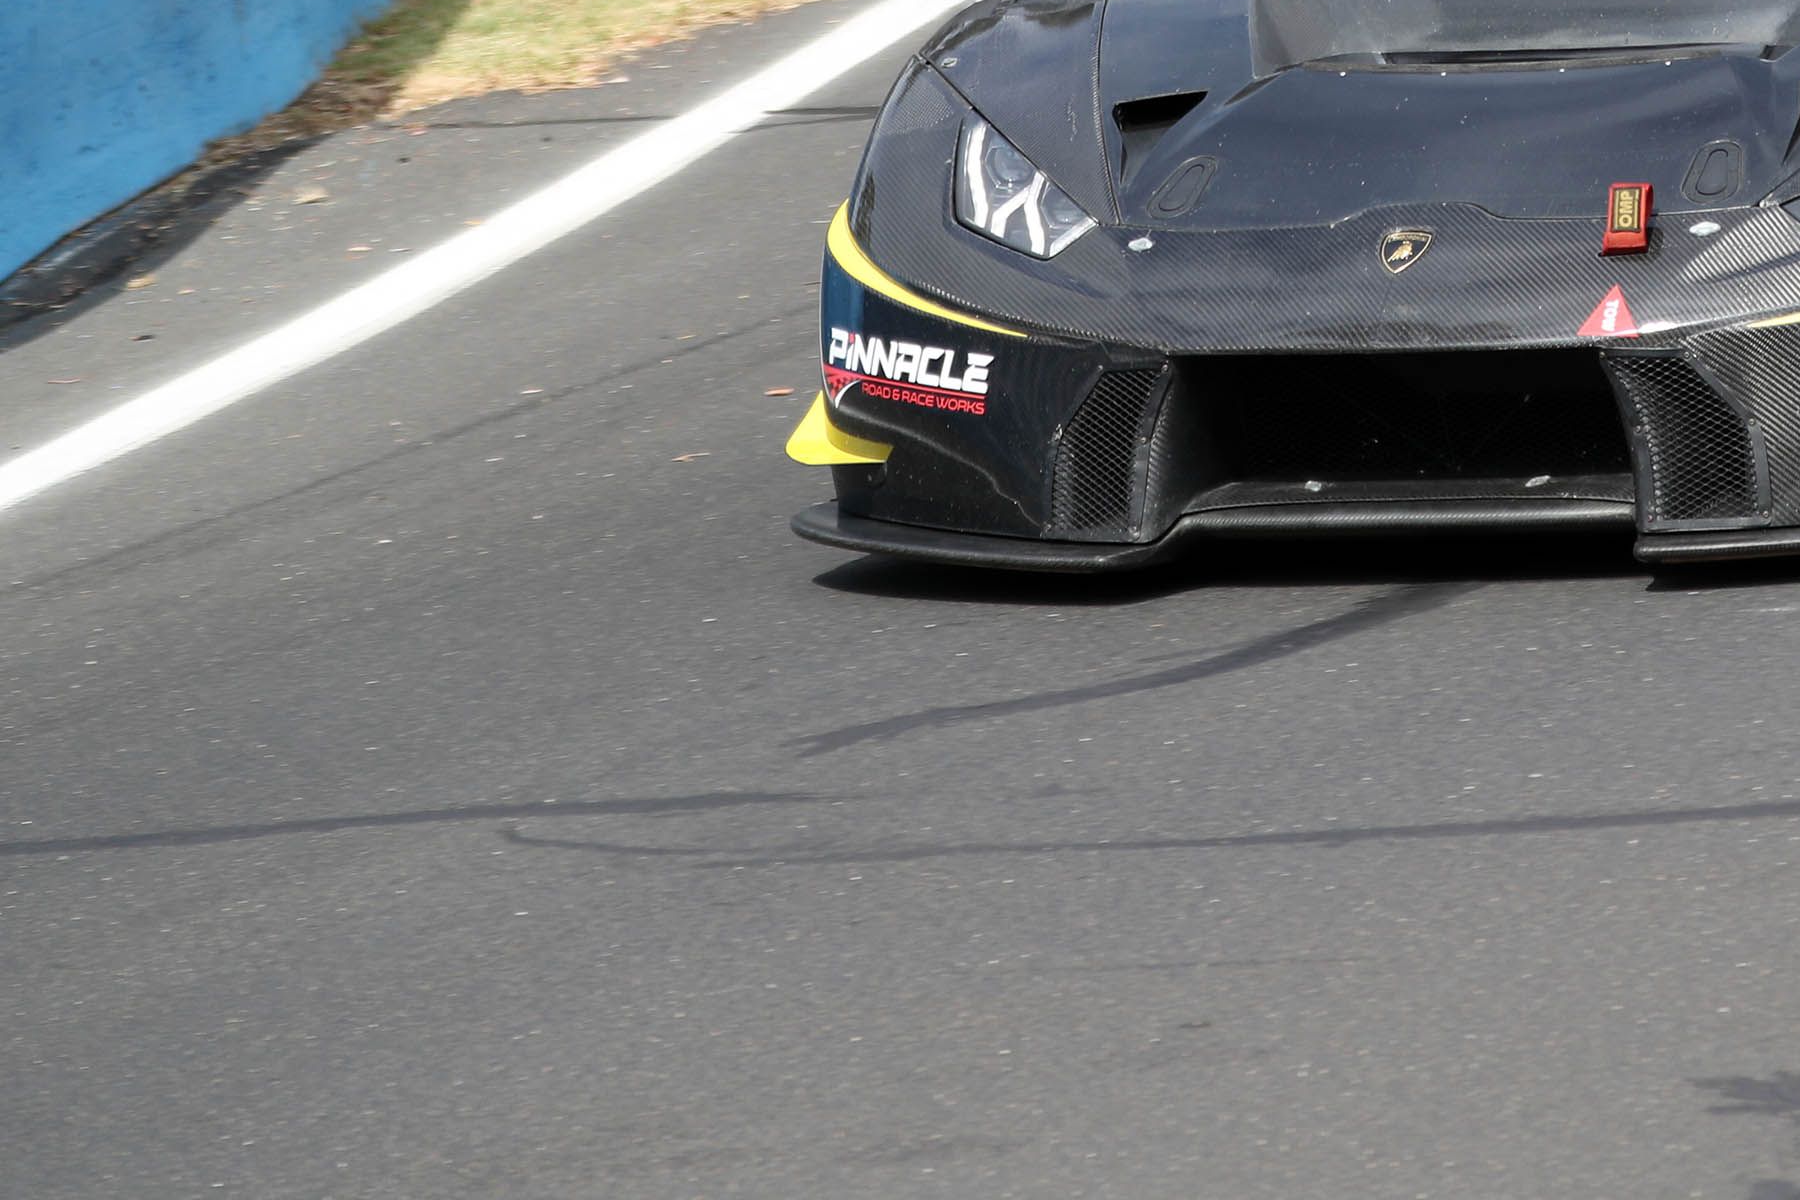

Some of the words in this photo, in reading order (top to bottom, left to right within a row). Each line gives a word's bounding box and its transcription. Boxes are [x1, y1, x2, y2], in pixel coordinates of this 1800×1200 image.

[1618, 190, 1635, 228] OMP
[861, 382, 891, 399] ROAD
[892, 388, 900, 400] &
[901, 392, 934, 408] RACE
[936, 397, 985, 415] WORKS
